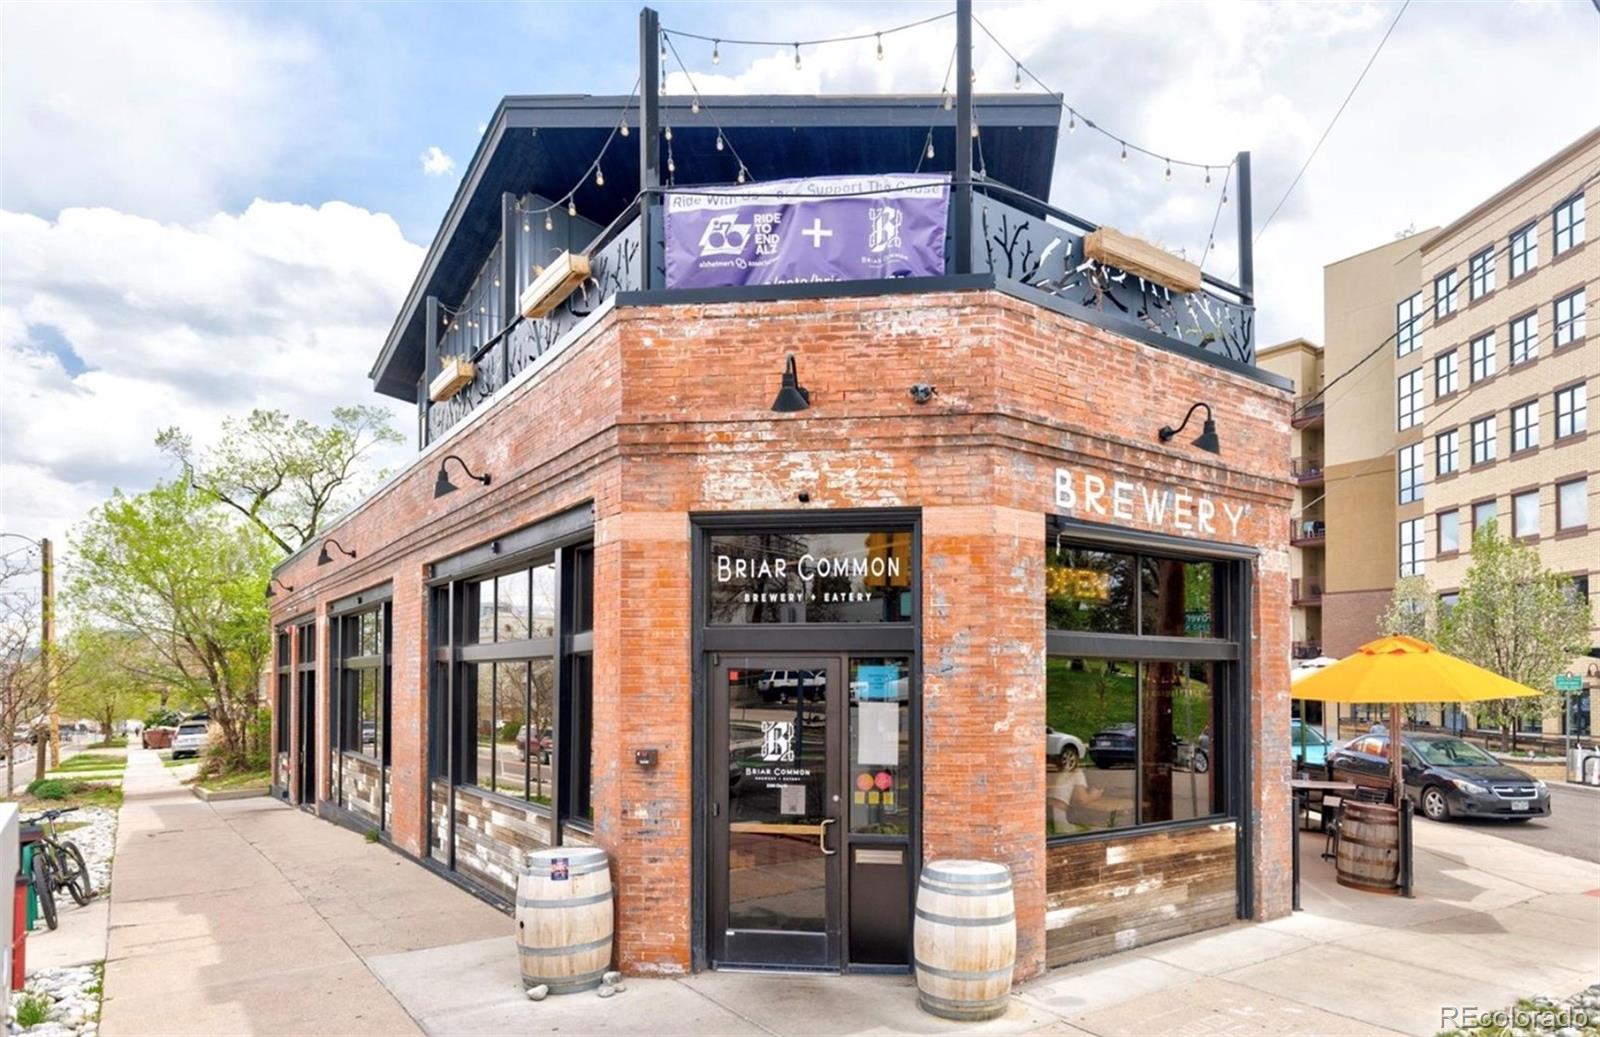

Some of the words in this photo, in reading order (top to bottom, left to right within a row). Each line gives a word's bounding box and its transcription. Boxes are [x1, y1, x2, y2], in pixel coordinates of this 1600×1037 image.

[672, 196, 702, 208] Ride
[807, 181, 863, 196] Support
[753, 213, 782, 224] RIDE
[754, 223, 772, 234] TO
[755, 234, 780, 244] END
[756, 245, 777, 255] ALZ
[1056, 467, 1244, 537] BREWERY
[717, 555, 787, 582] BRIAR
[797, 554, 900, 581] COMMON
[744, 592, 804, 602] BREWERY
[823, 592, 871, 602] EATERY
[745, 767, 771, 776] BRIAR
[773, 767, 811, 776] COMMON
